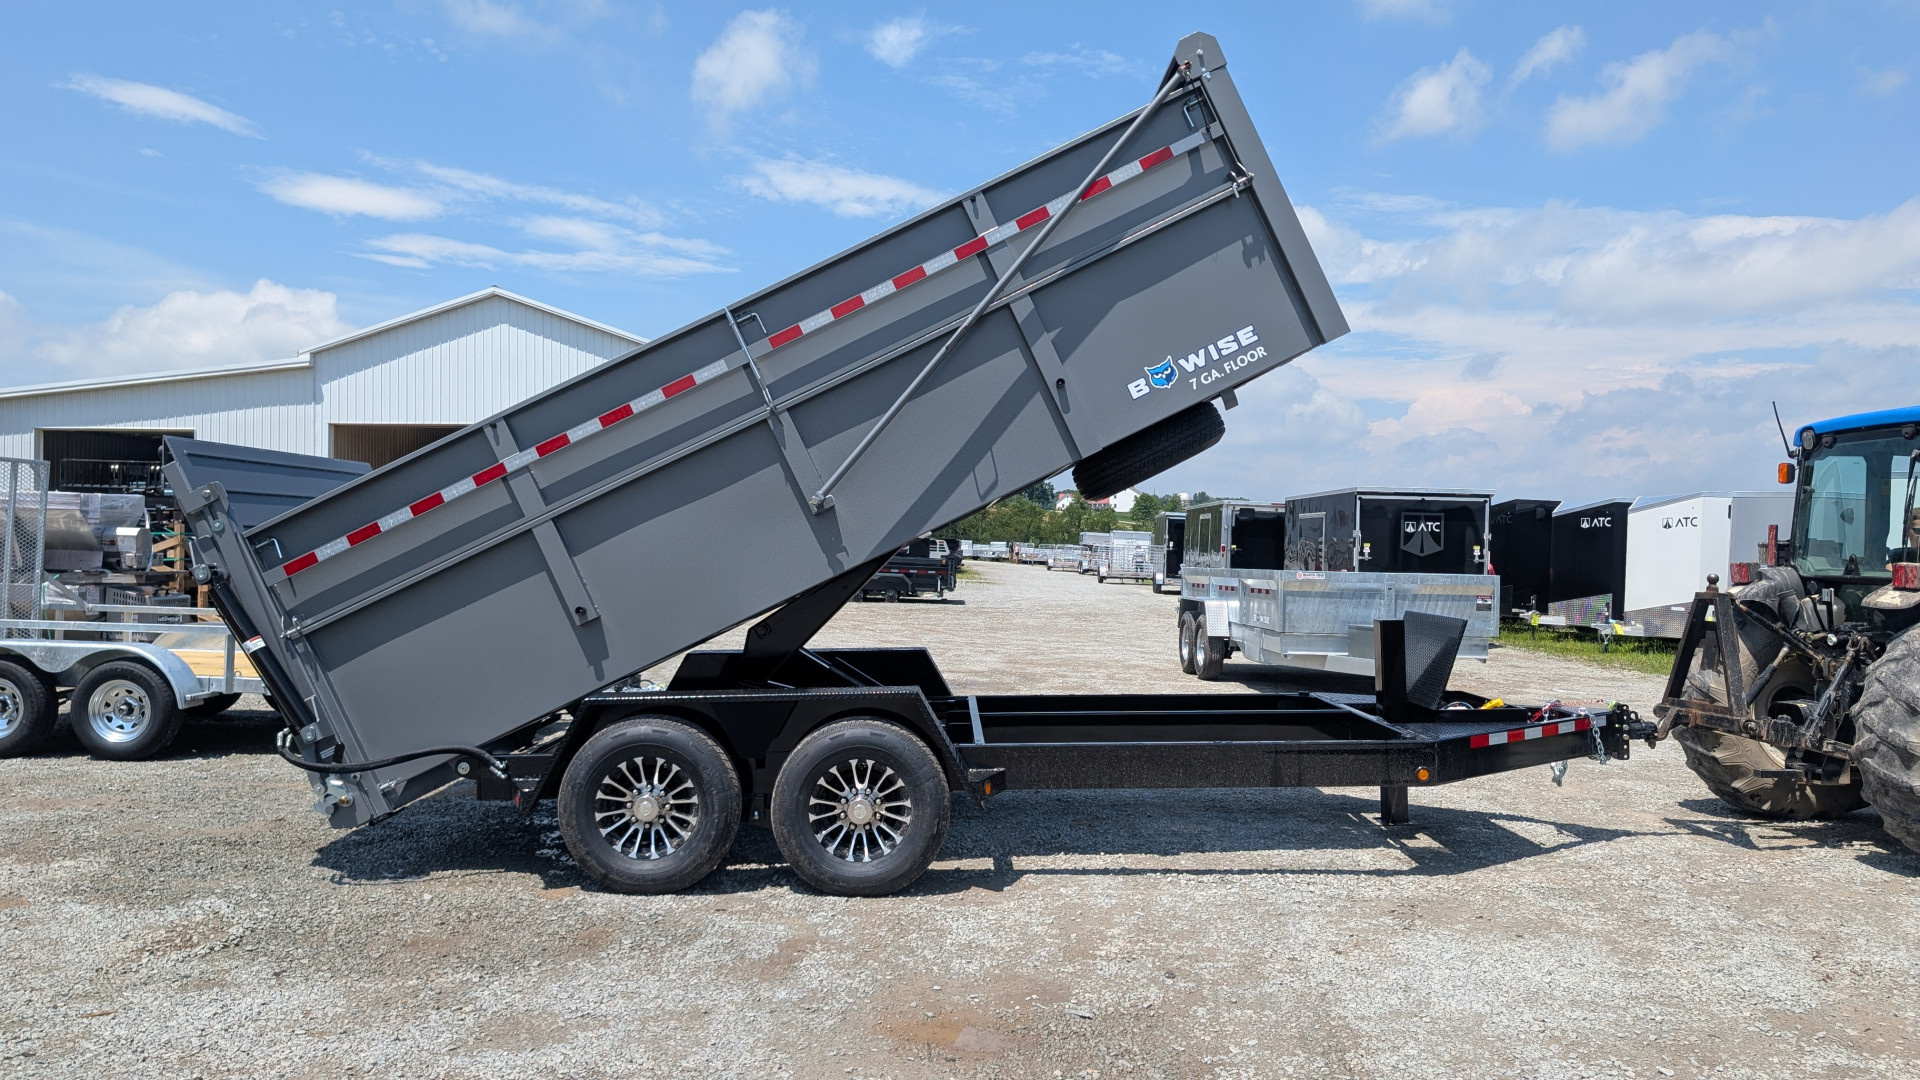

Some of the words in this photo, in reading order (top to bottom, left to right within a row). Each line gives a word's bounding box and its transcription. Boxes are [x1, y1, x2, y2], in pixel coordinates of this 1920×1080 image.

[1188, 377, 1198, 391] 7
[1201, 368, 1225, 385] GA.
[1224, 345, 1268, 375] FLOOR
[1417, 521, 1441, 532] ATC
[1591, 517, 1612, 527] ATC
[1675, 516, 1699, 527] ATC
